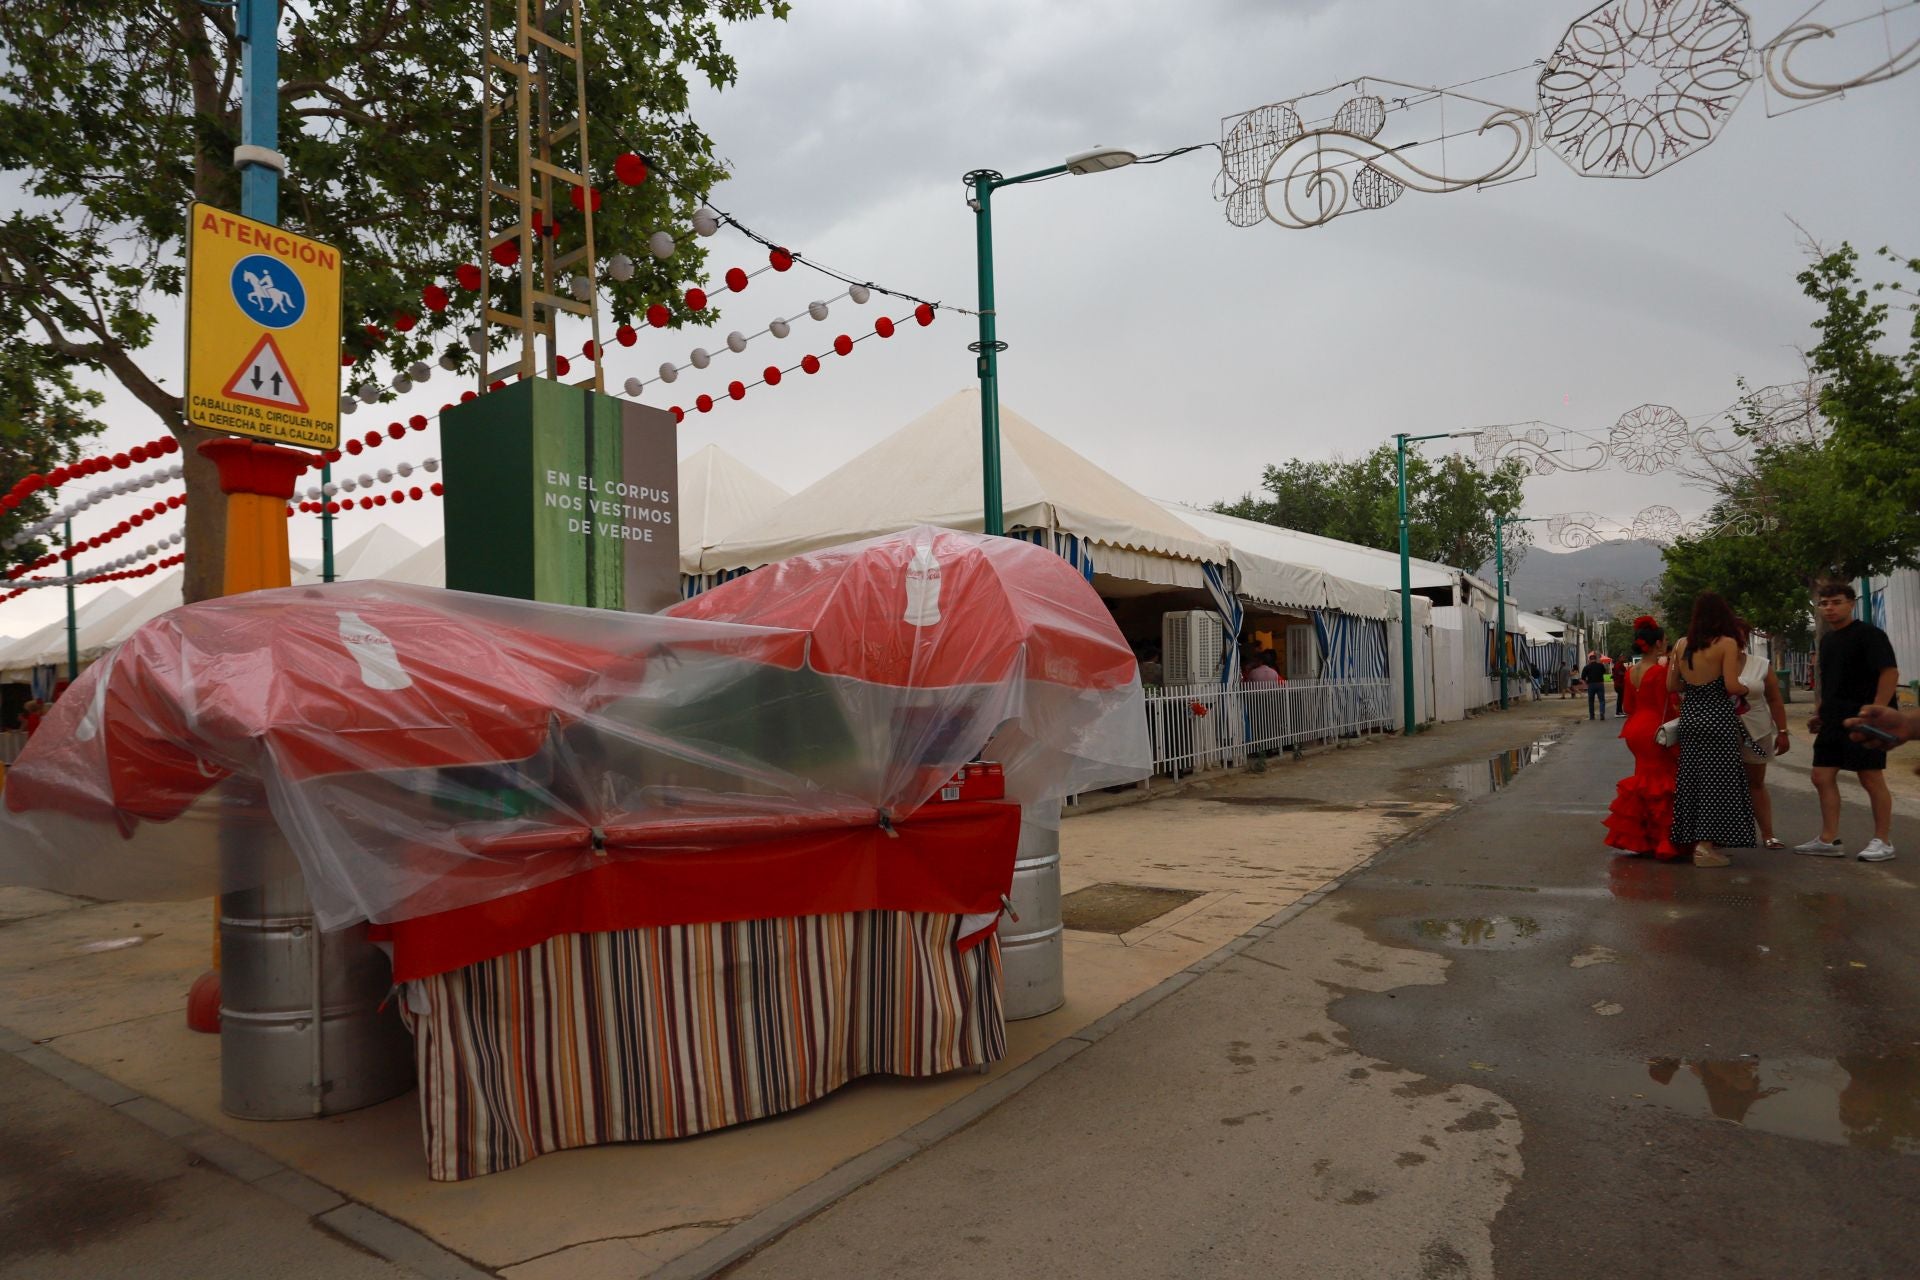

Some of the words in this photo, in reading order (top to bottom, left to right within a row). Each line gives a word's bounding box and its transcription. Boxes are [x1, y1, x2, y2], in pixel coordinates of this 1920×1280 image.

[202, 213, 335, 270] ATENCIÓN
[192, 395, 263, 420] CABALLISTAS,
[266, 410, 312, 428] CIRCULEN
[315, 420, 334, 432] POR
[193, 409, 206, 422] LA
[209, 413, 256, 431] DERECHA
[260, 422, 272, 434] DE
[275, 426, 286, 438] LA
[289, 428, 332, 445] CALZADA
[547, 470, 570, 487] EN
[578, 475, 598, 492] EL
[604, 480, 669, 504] CORPUS
[545, 492, 582, 511] NOS
[589, 499, 671, 525] VESTIMOS
[568, 518, 591, 535] DE
[598, 522, 653, 543] VERDE
